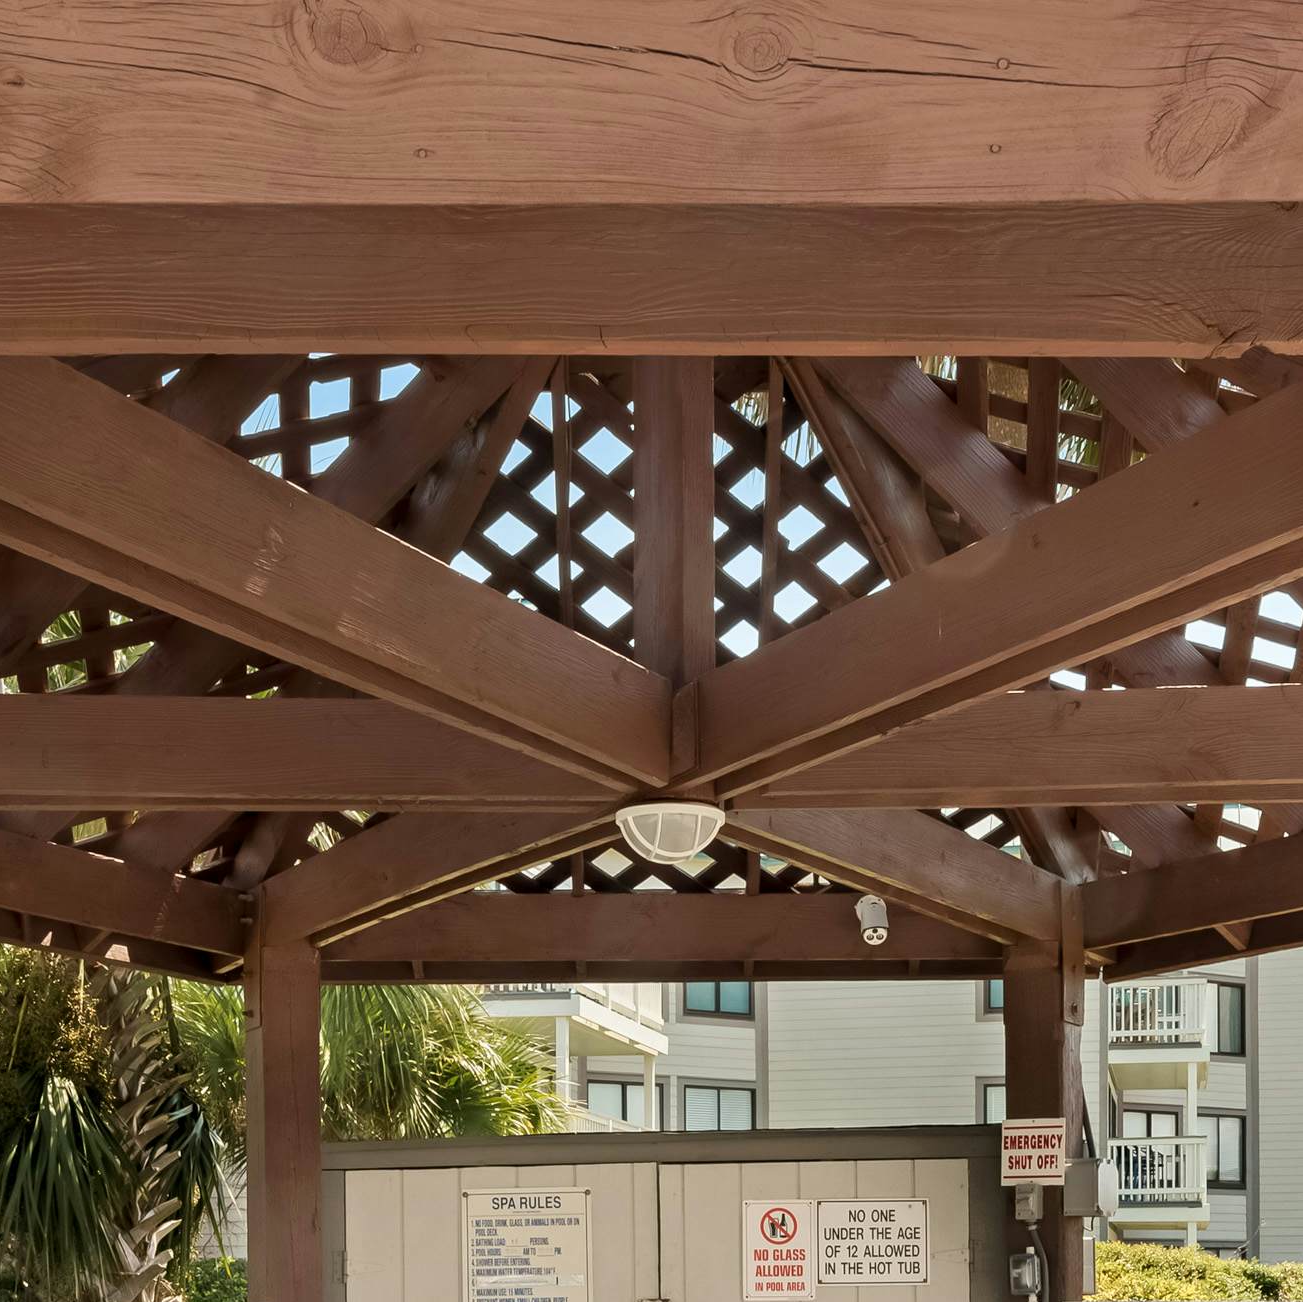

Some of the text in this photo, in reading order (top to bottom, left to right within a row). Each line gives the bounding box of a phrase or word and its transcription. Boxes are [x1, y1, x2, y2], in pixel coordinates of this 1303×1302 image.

[1004, 1134, 1063, 1150] EMERGENCY
[1008, 1155, 1058, 1170] SHUT OFF!
[492, 1196, 561, 1209] SPA RULES
[531, 1218, 549, 1226] ANIMALS
[551, 1218, 554, 1226] IN
[555, 1218, 565, 1226] POOL
[849, 1210, 896, 1222] NO ONE
[824, 1227, 921, 1240] UNDER THE AGE
[754, 1249, 806, 1261] NO GLASS
[825, 1245, 920, 1258] OF 12 ALLOWED
[476, 1268, 497, 1276] MAXIMUM
[756, 1265, 803, 1277] ALLOWED
[825, 1262, 920, 1275] IN THE HOT TUB
[477, 1288, 497, 1296] MAXIMUM
[755, 1282, 805, 1291] IN POOL AREA
